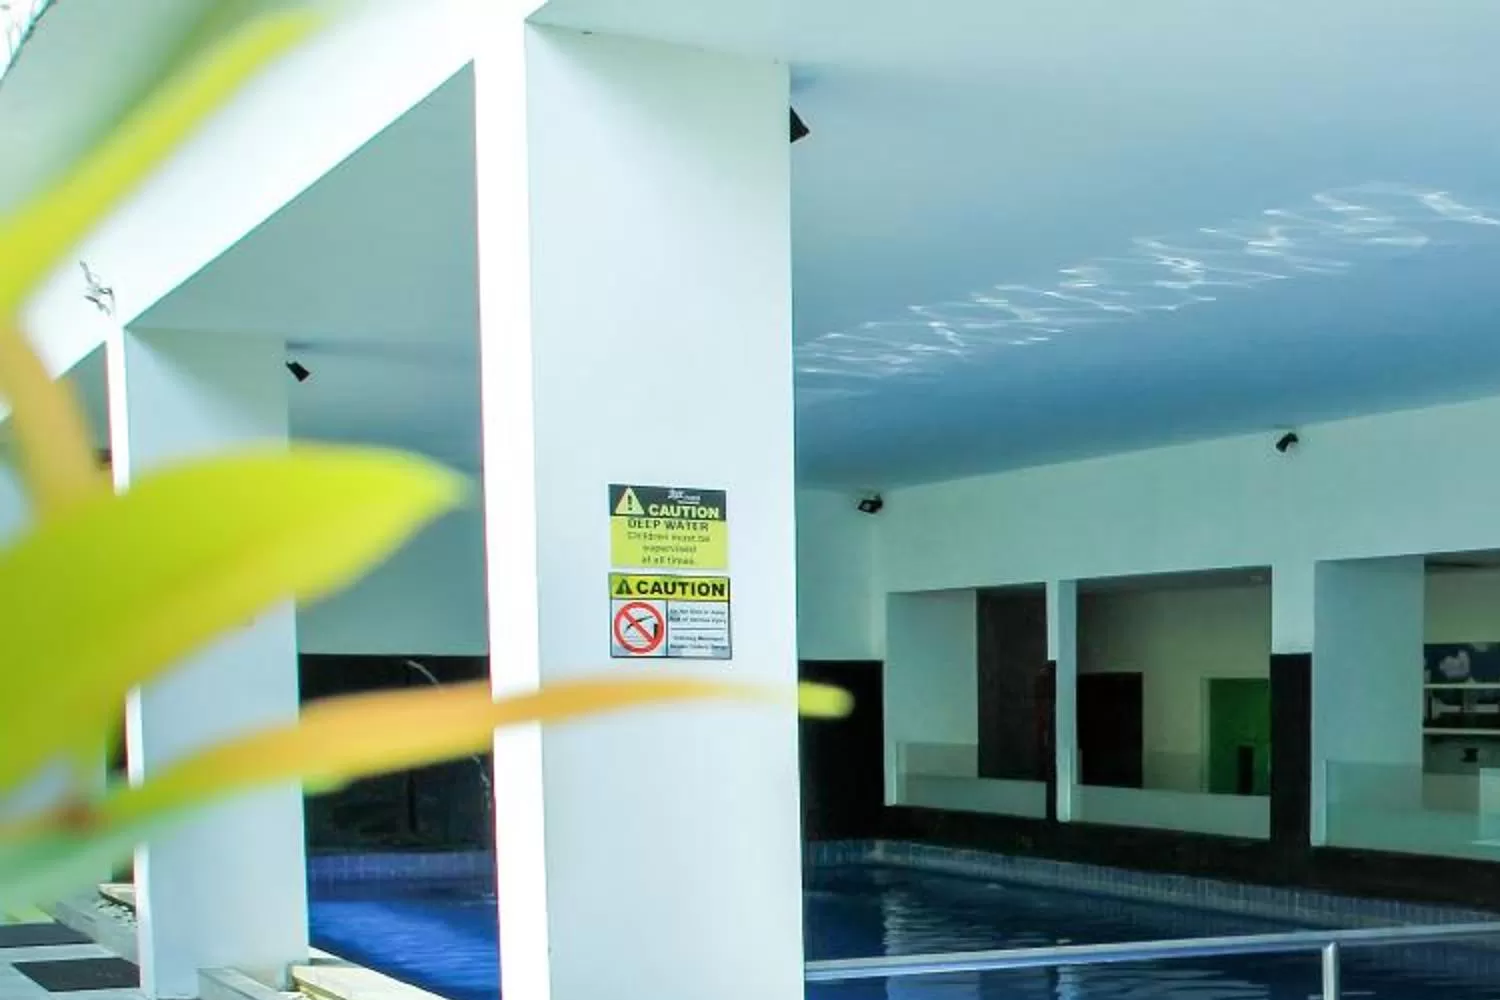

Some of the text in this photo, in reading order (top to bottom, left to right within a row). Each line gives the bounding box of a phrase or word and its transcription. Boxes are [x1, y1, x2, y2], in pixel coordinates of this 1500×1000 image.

[648, 504, 720, 519] CAUTION
[627, 518, 709, 532] DEEP WATER
[636, 579, 726, 597] CAUTION
